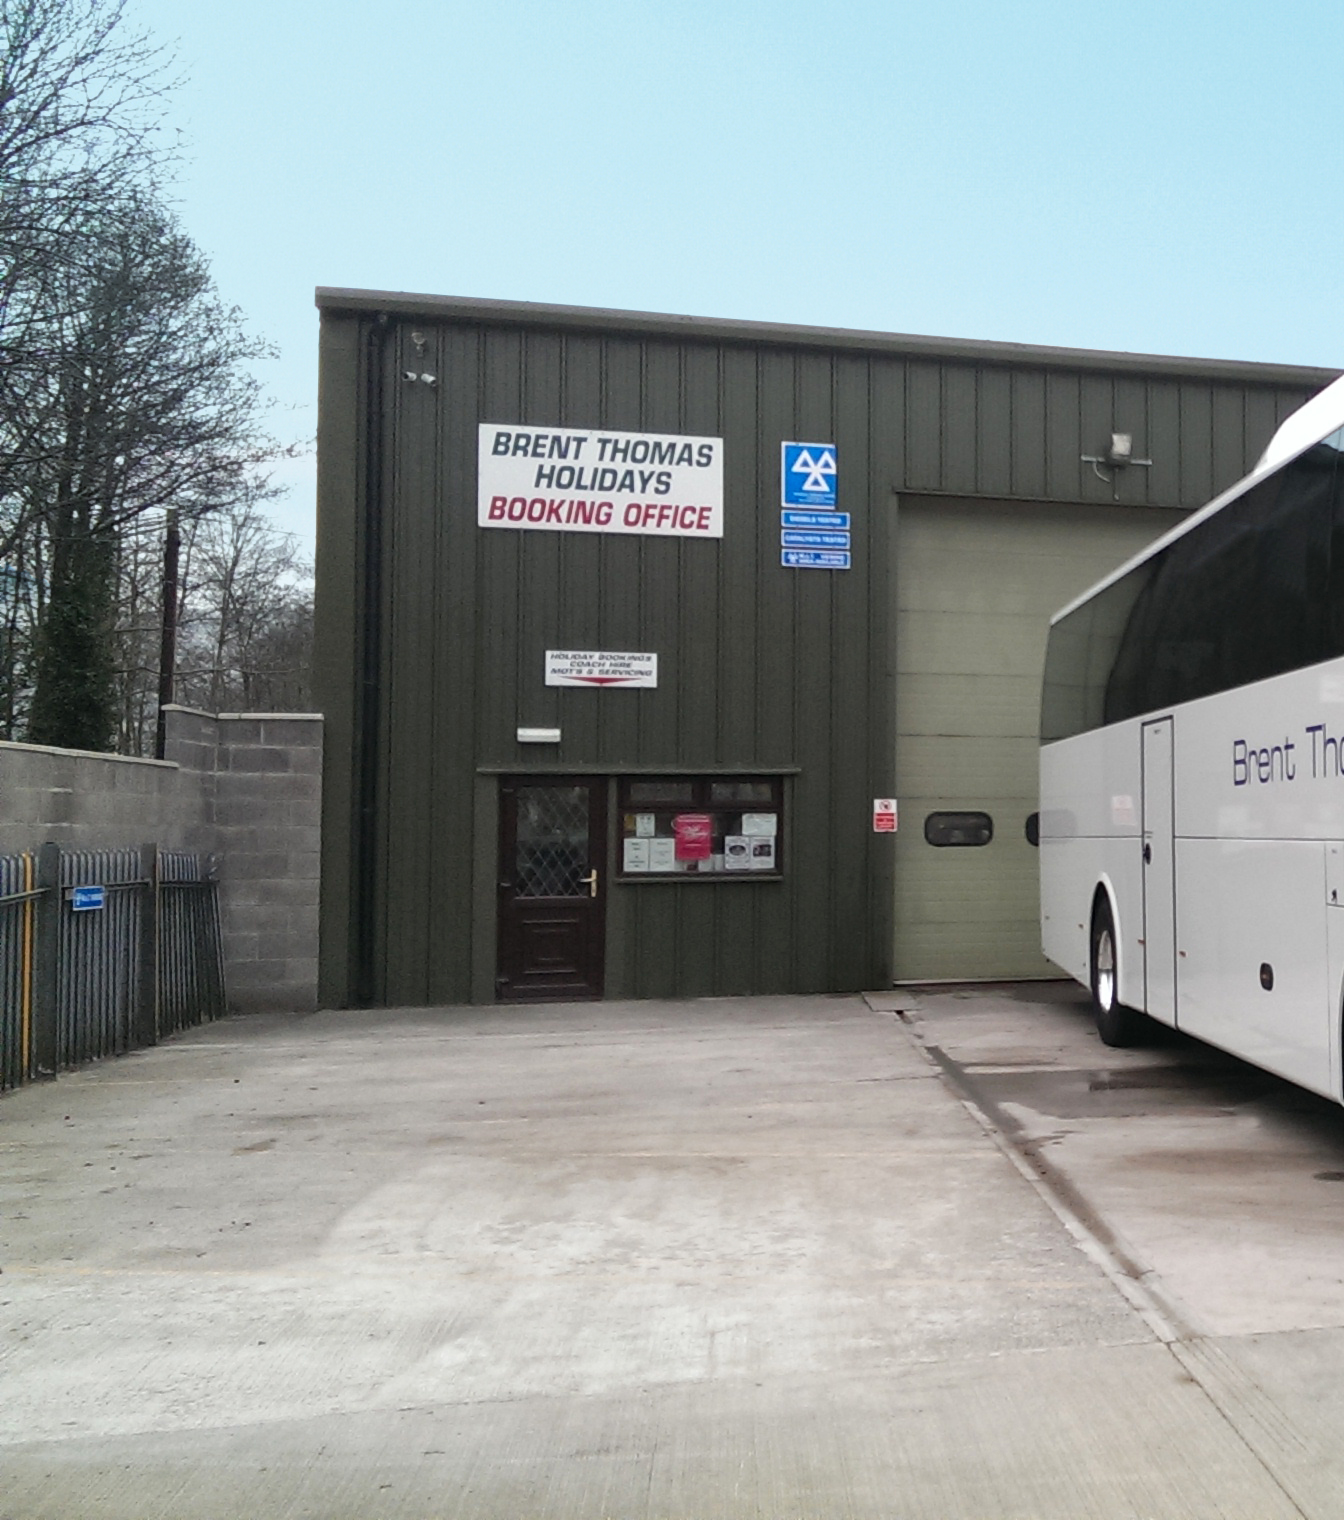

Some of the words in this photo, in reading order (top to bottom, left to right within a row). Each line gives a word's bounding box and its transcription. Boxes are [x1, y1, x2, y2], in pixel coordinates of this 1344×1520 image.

[491, 431, 588, 460] BRENT
[597, 437, 714, 467] THOMAS
[534, 464, 672, 495] HOLIDAYS
[488, 495, 614, 526] BOOKING
[623, 502, 712, 530] OFFICE
[598, 654, 652, 662] BOOKINGS
[1233, 736, 1296, 786] Brent
